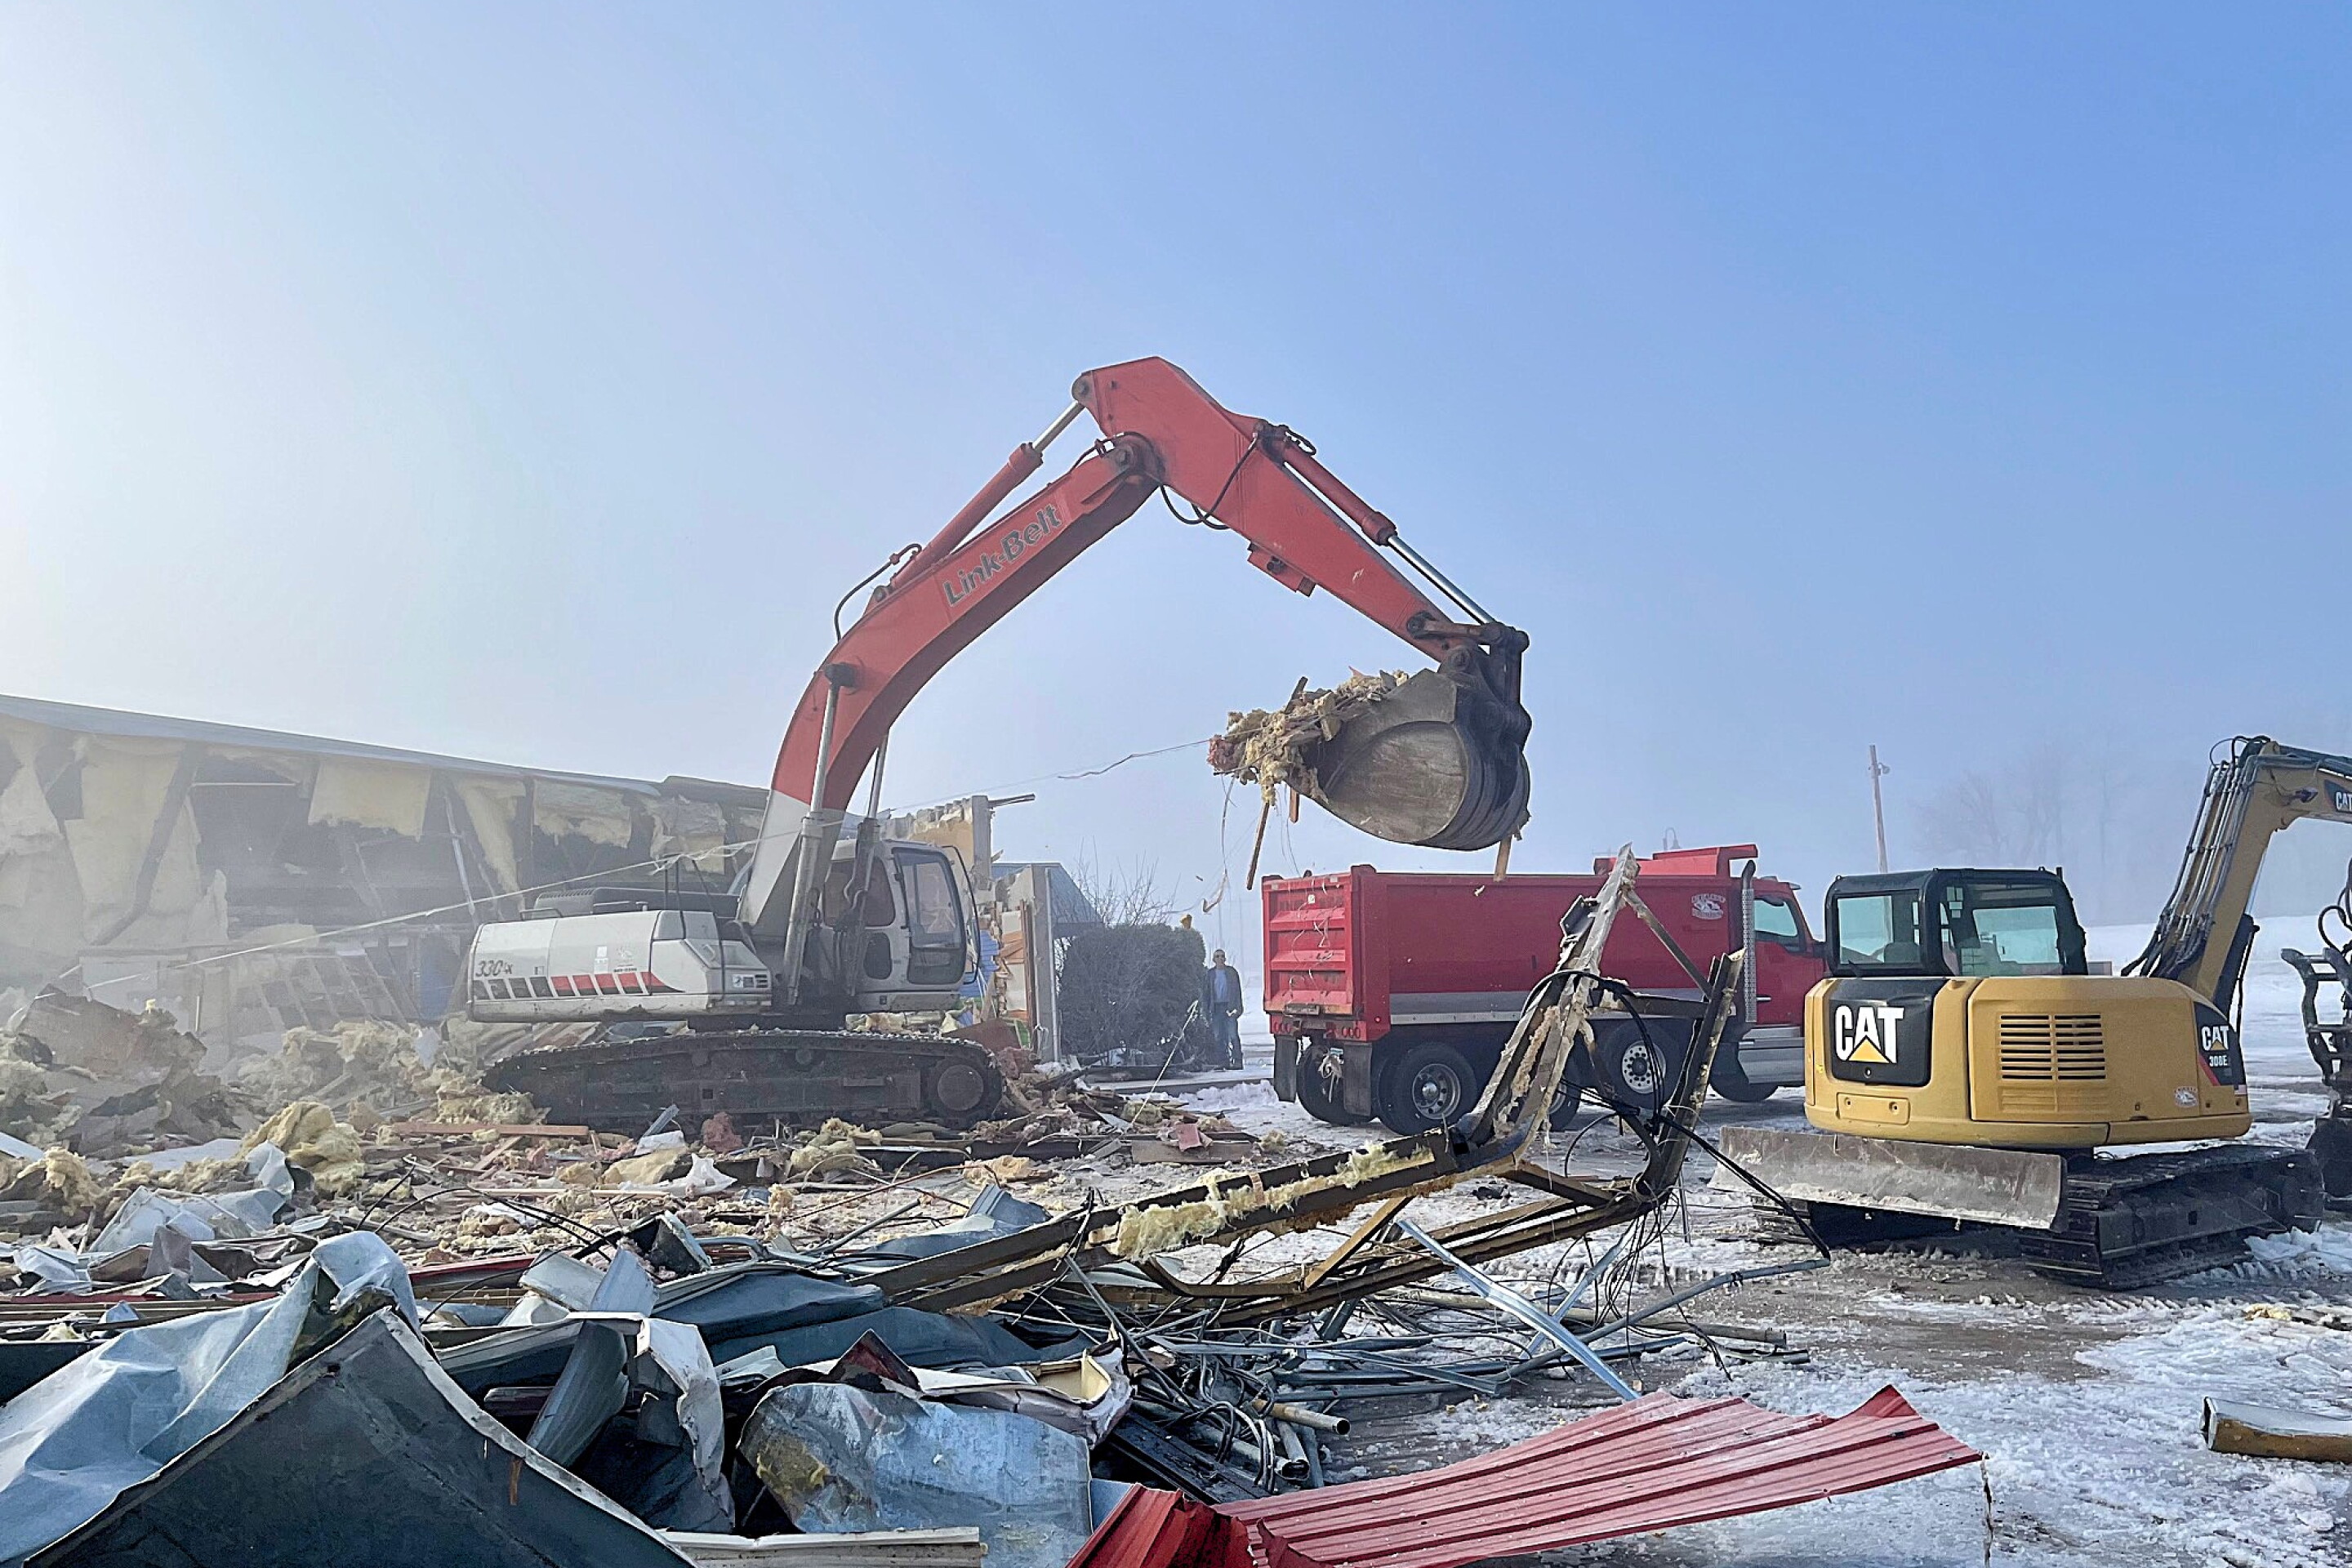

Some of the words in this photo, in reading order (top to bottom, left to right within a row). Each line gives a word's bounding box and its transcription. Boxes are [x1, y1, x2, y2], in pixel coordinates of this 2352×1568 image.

[943, 504, 1062, 607] Link-Belt
[1835, 1004, 1904, 1063] CAT
[2201, 1025, 2230, 1051] CAT
